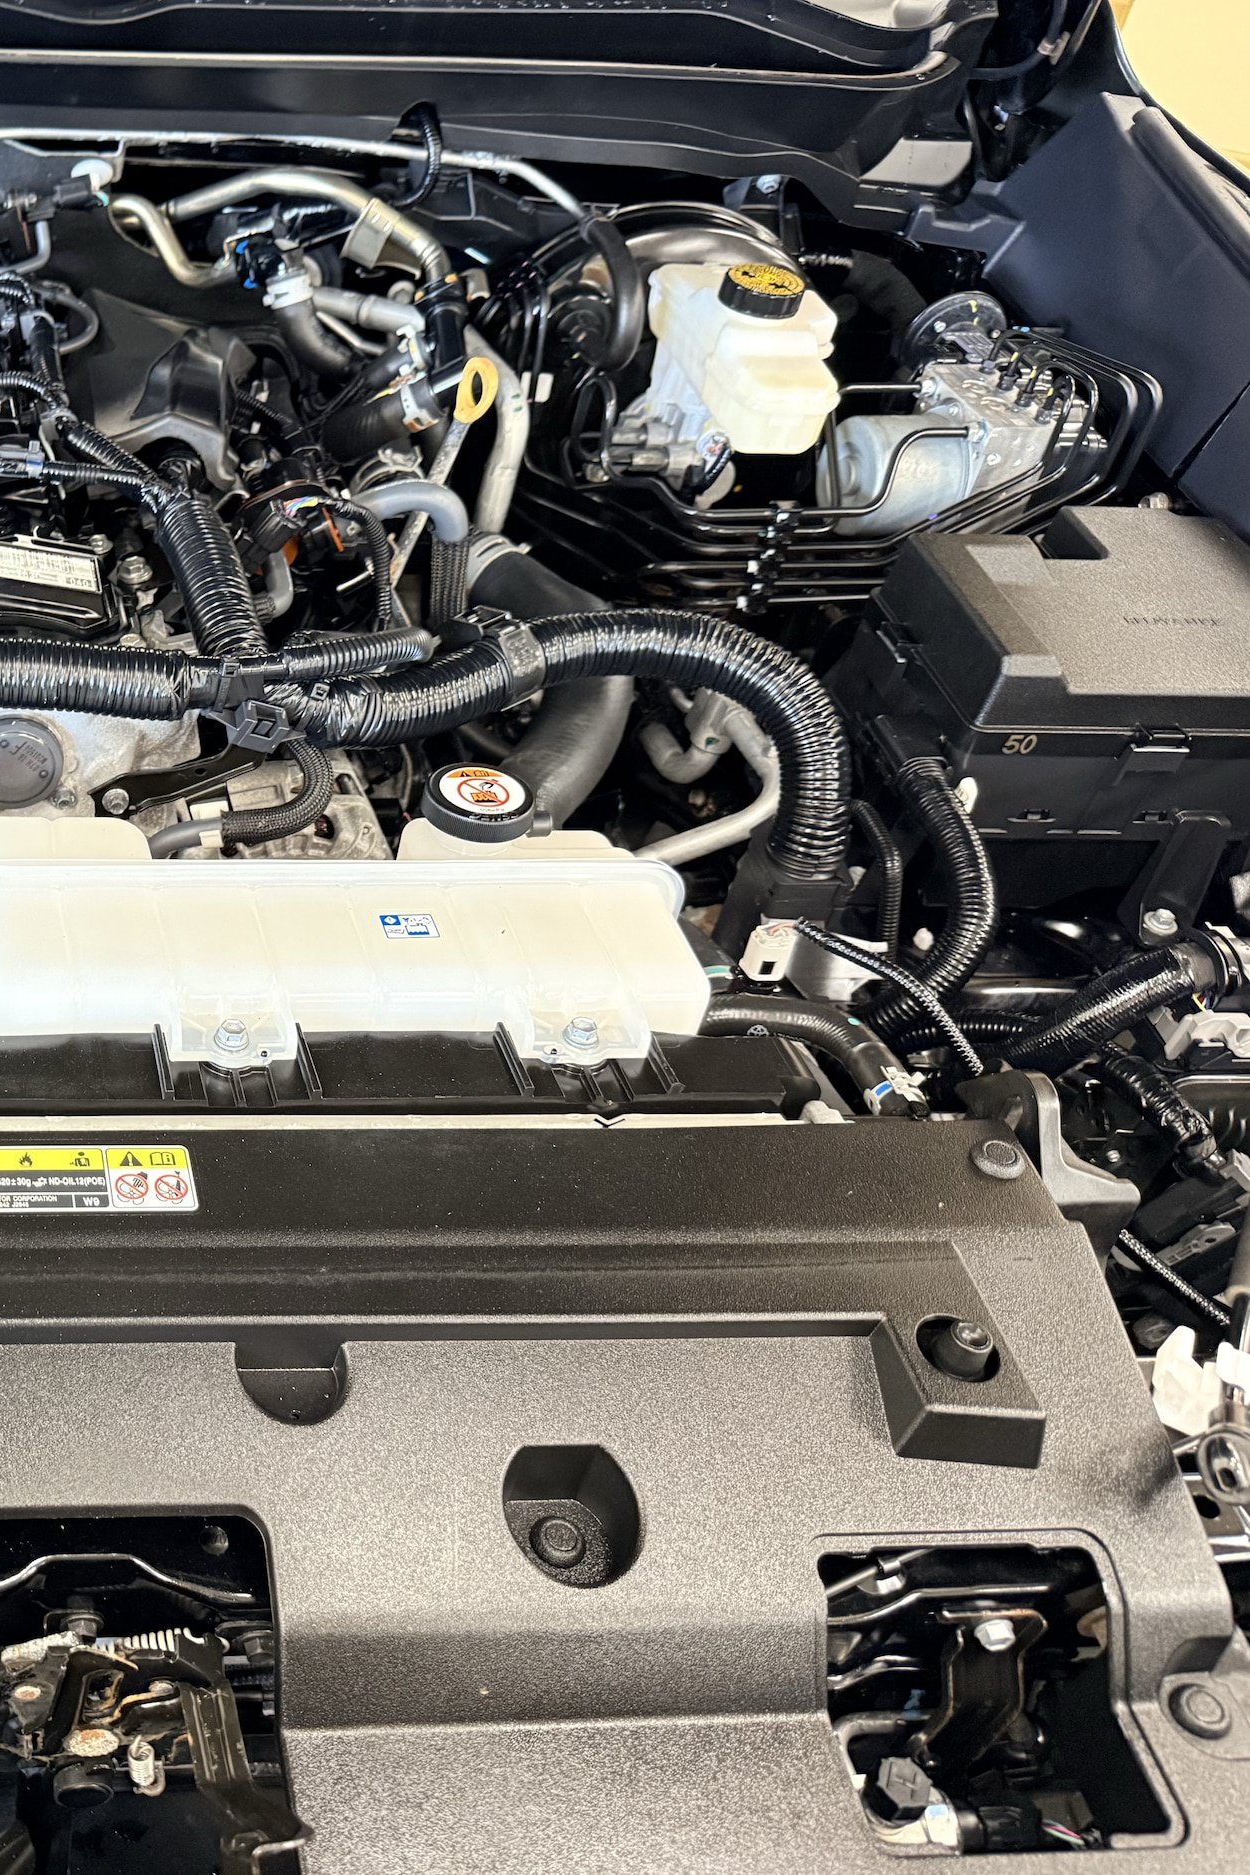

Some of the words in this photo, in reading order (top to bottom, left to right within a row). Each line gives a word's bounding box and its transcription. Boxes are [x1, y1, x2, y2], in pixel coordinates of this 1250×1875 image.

[1001, 734, 1038, 755] 50
[48, 1176, 106, 1187] ND-OIL12(POE)
[83, 1196, 101, 1207] W9
